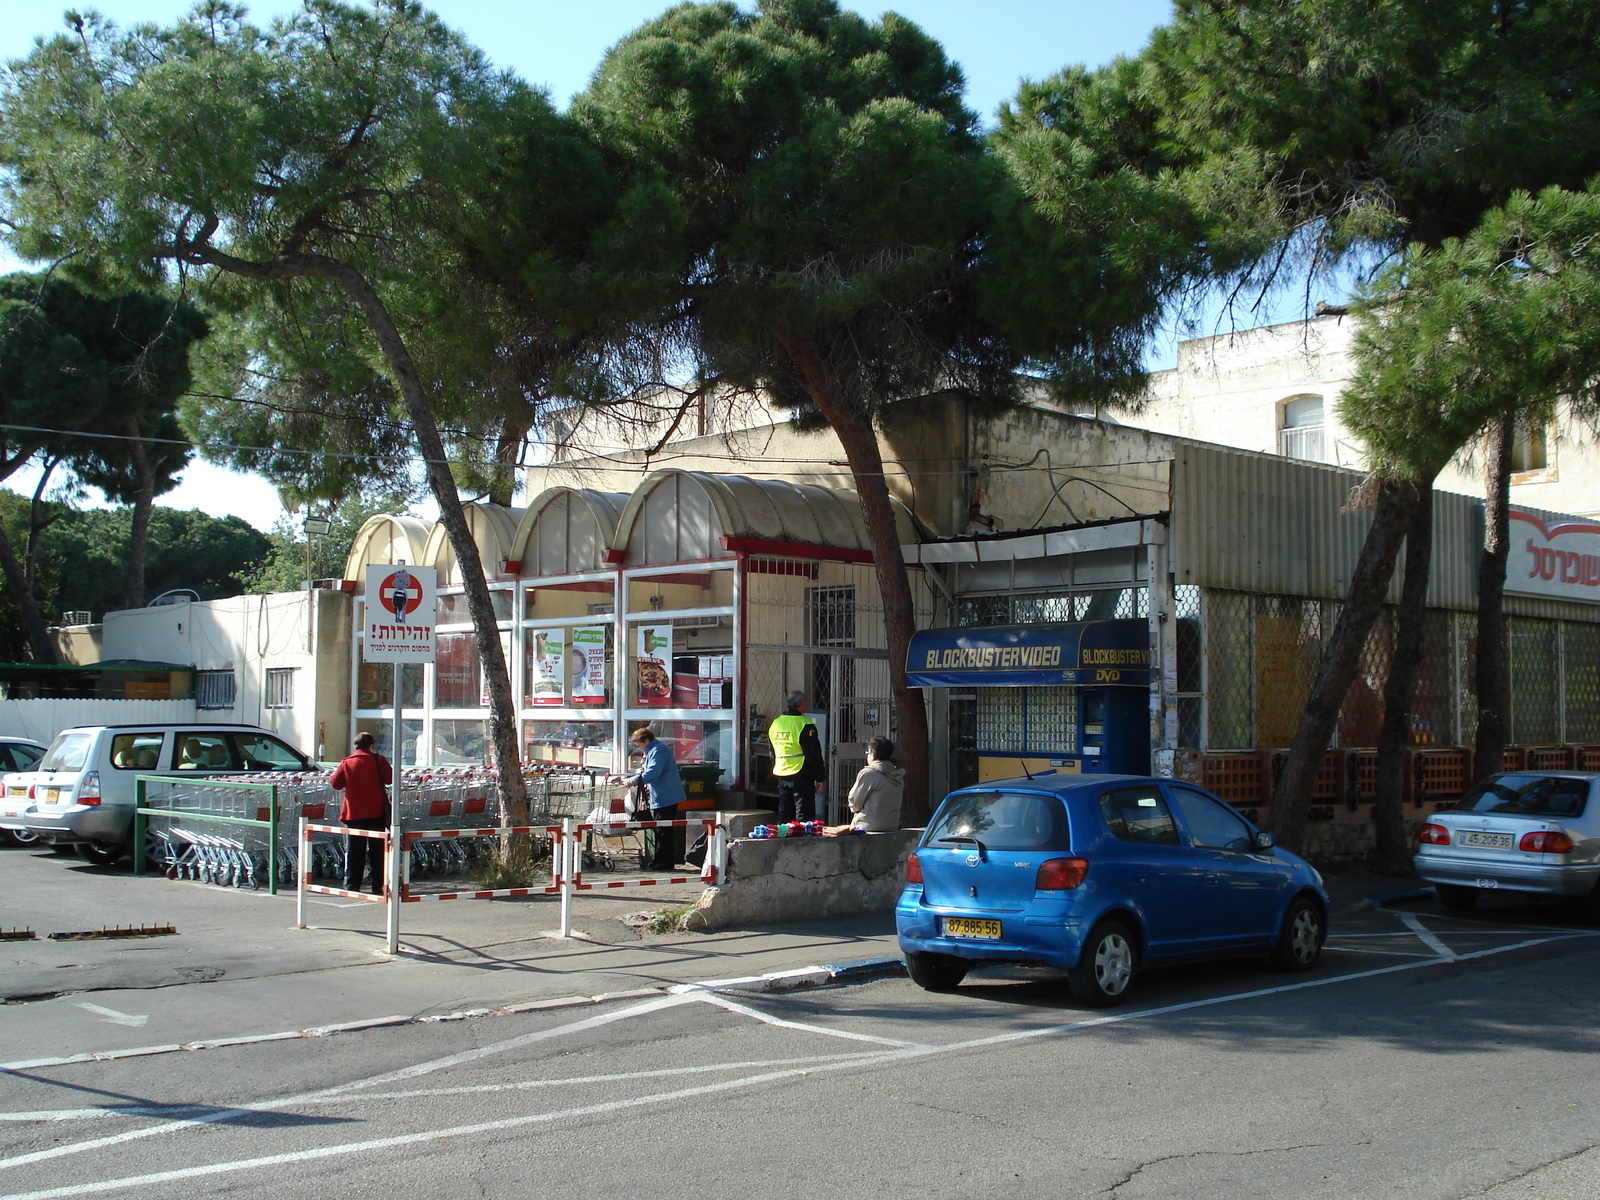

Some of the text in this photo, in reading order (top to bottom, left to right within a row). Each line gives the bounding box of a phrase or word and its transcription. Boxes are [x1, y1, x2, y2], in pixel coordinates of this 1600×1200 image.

[371, 624, 431, 641] זהירות!
[1083, 649, 1141, 664] BLOCKBUSTER
[1096, 669, 1120, 682] DVD
